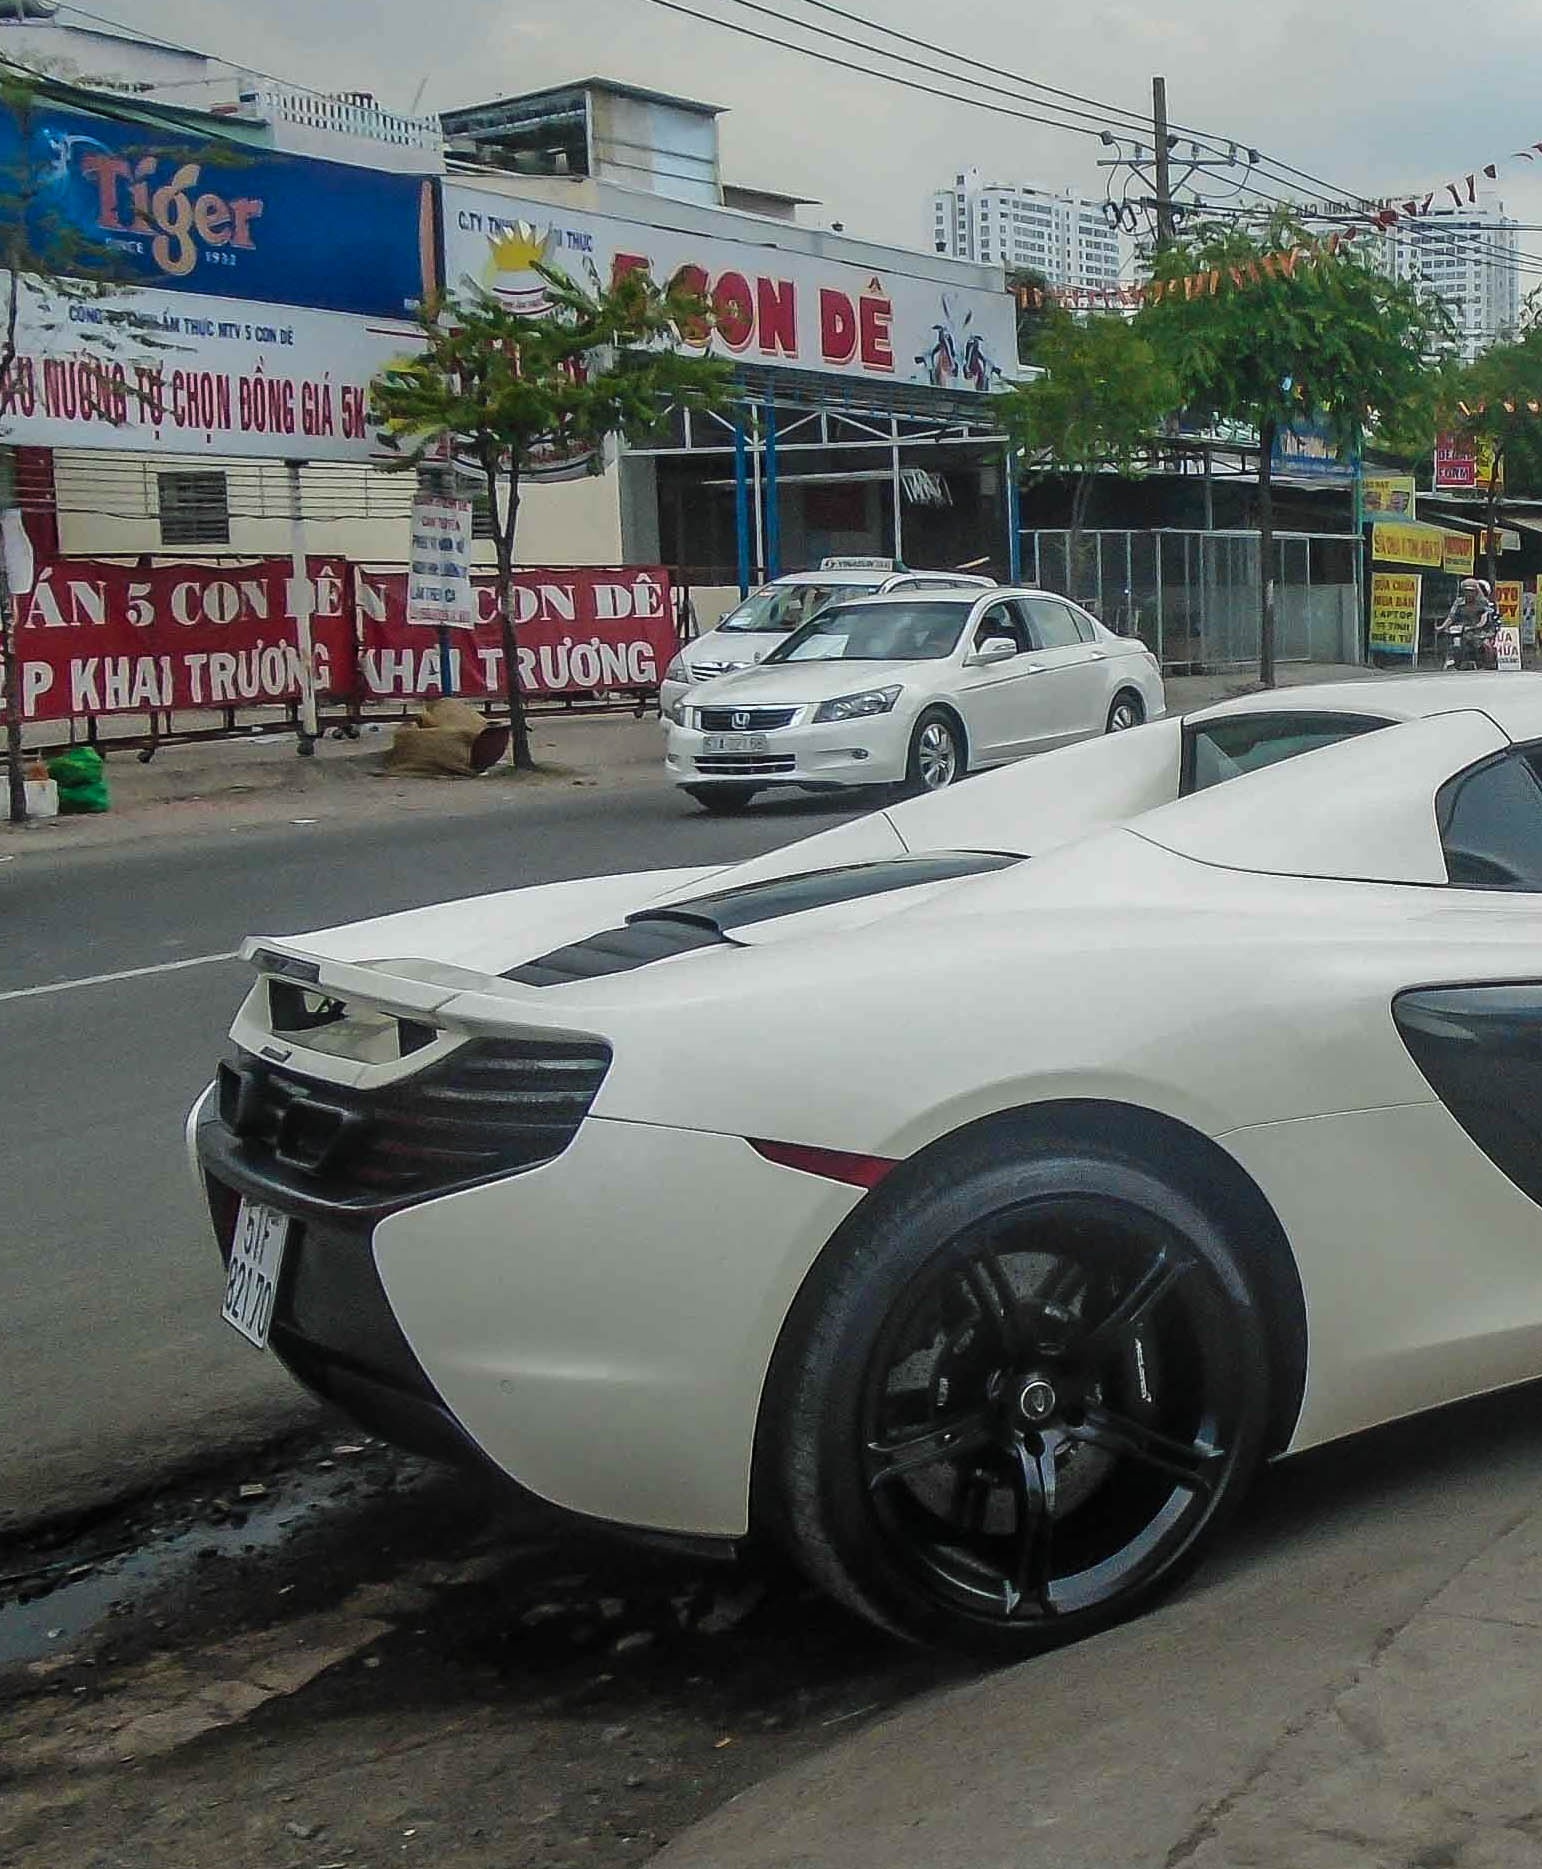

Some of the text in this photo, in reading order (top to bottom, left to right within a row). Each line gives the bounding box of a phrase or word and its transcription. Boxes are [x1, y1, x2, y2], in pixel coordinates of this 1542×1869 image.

[80, 152, 264, 276] Tiger
[254, 325, 278, 344] CON
[668, 262, 799, 359] CON
[818, 276, 896, 373] DÊ
[171, 368, 232, 443] CHỌN
[302, 370, 334, 438] GIÁ
[126, 582, 156, 628] 5
[170, 578, 269, 626] CON
[472, 572, 666, 625] CON DÊ
[71, 655, 173, 712] KHAI
[184, 638, 331, 703] TRƯƠNG
[477, 636, 658, 693] TRƯƠNG
